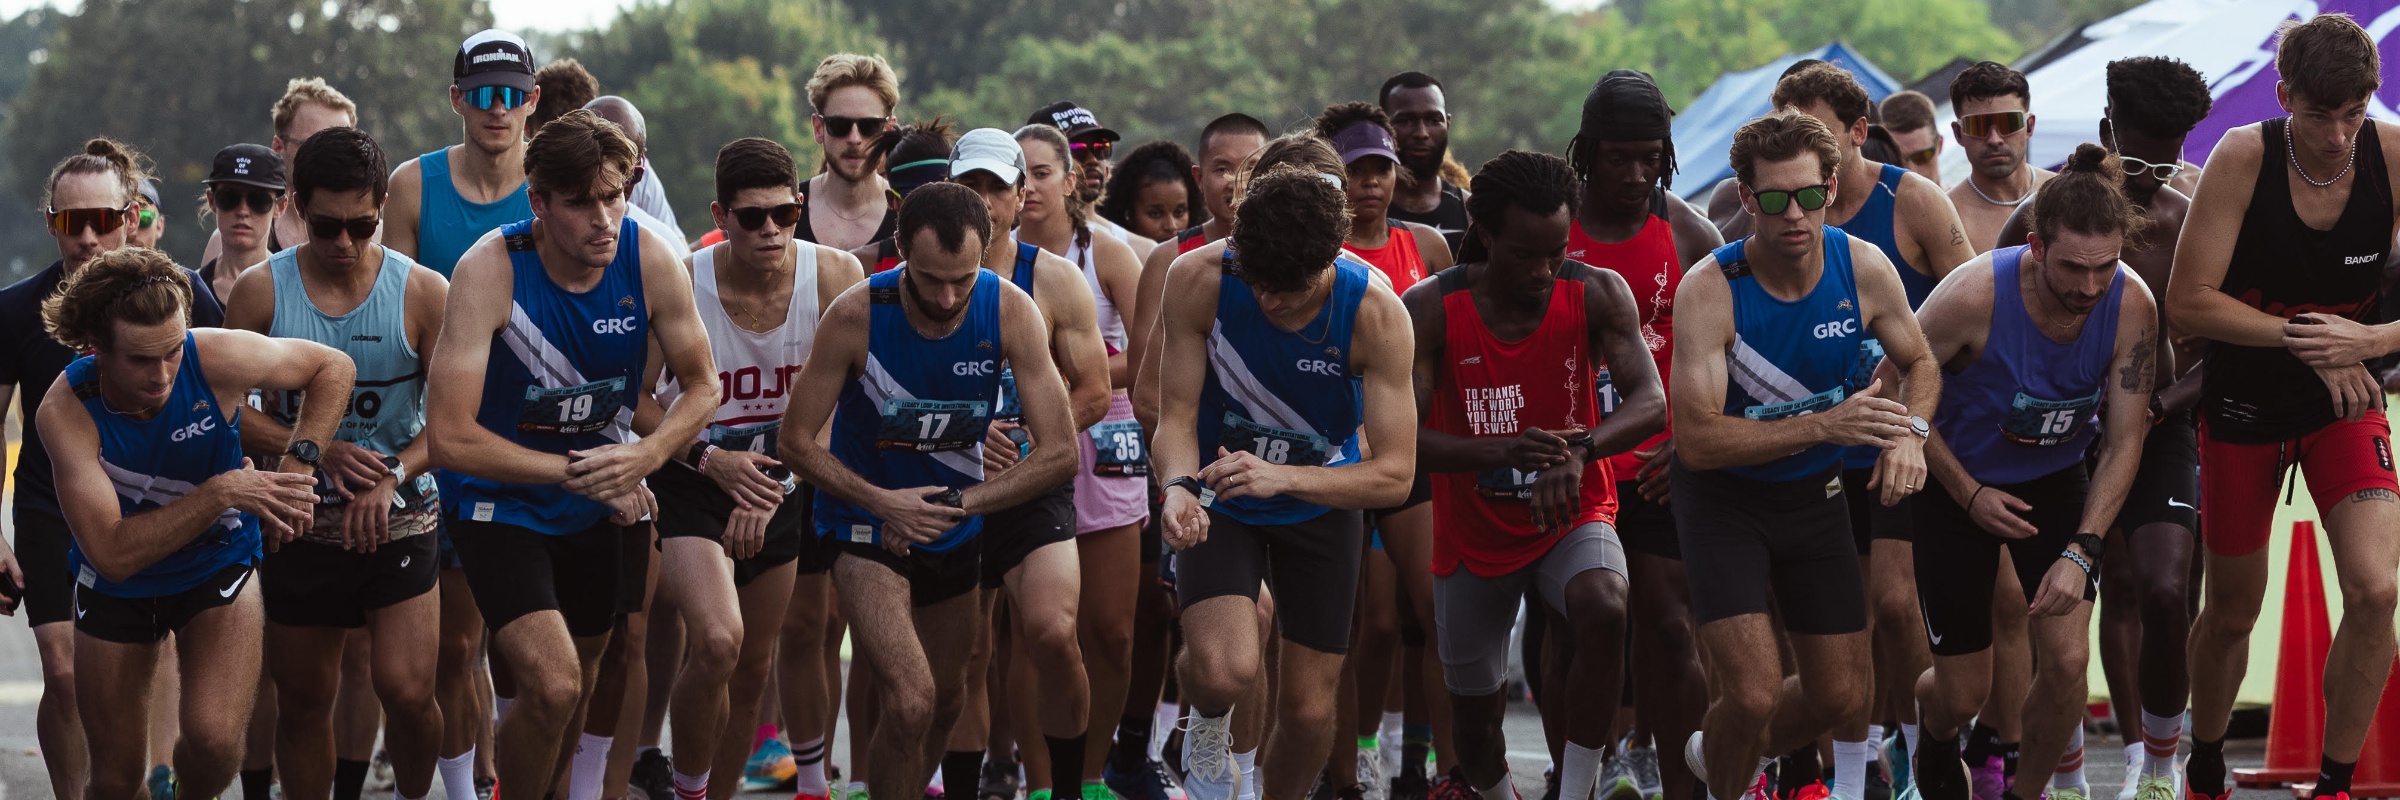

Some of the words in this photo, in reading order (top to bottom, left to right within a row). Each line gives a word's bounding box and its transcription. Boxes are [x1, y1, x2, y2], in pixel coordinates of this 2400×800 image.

[473, 50, 518, 64] IRONMAN
[1071, 115, 1098, 126] dop
[2344, 253, 2379, 265] BANDIT
[593, 316, 636, 334] GRC
[1813, 318, 1856, 339] GRC
[953, 360, 994, 376] GRC
[1296, 359, 1341, 377] GRC
[1465, 388, 1478, 400] TO
[1482, 384, 1521, 399] CHANGE
[558, 394, 592, 422] 19
[1466, 400, 1484, 412] THE
[1489, 396, 1524, 411] WORLD
[1762, 407, 1780, 415] LEGACY
[1467, 411, 1486, 423] YOU
[1491, 409, 1516, 423] HAVE
[2040, 409, 2075, 434] 15
[171, 415, 216, 442] GRC
[918, 413, 951, 439] 17
[1484, 420, 1518, 435] SWEAT
[747, 433, 765, 456] 4
[1113, 432, 1140, 460] 35
[1253, 436, 1289, 465] 18
